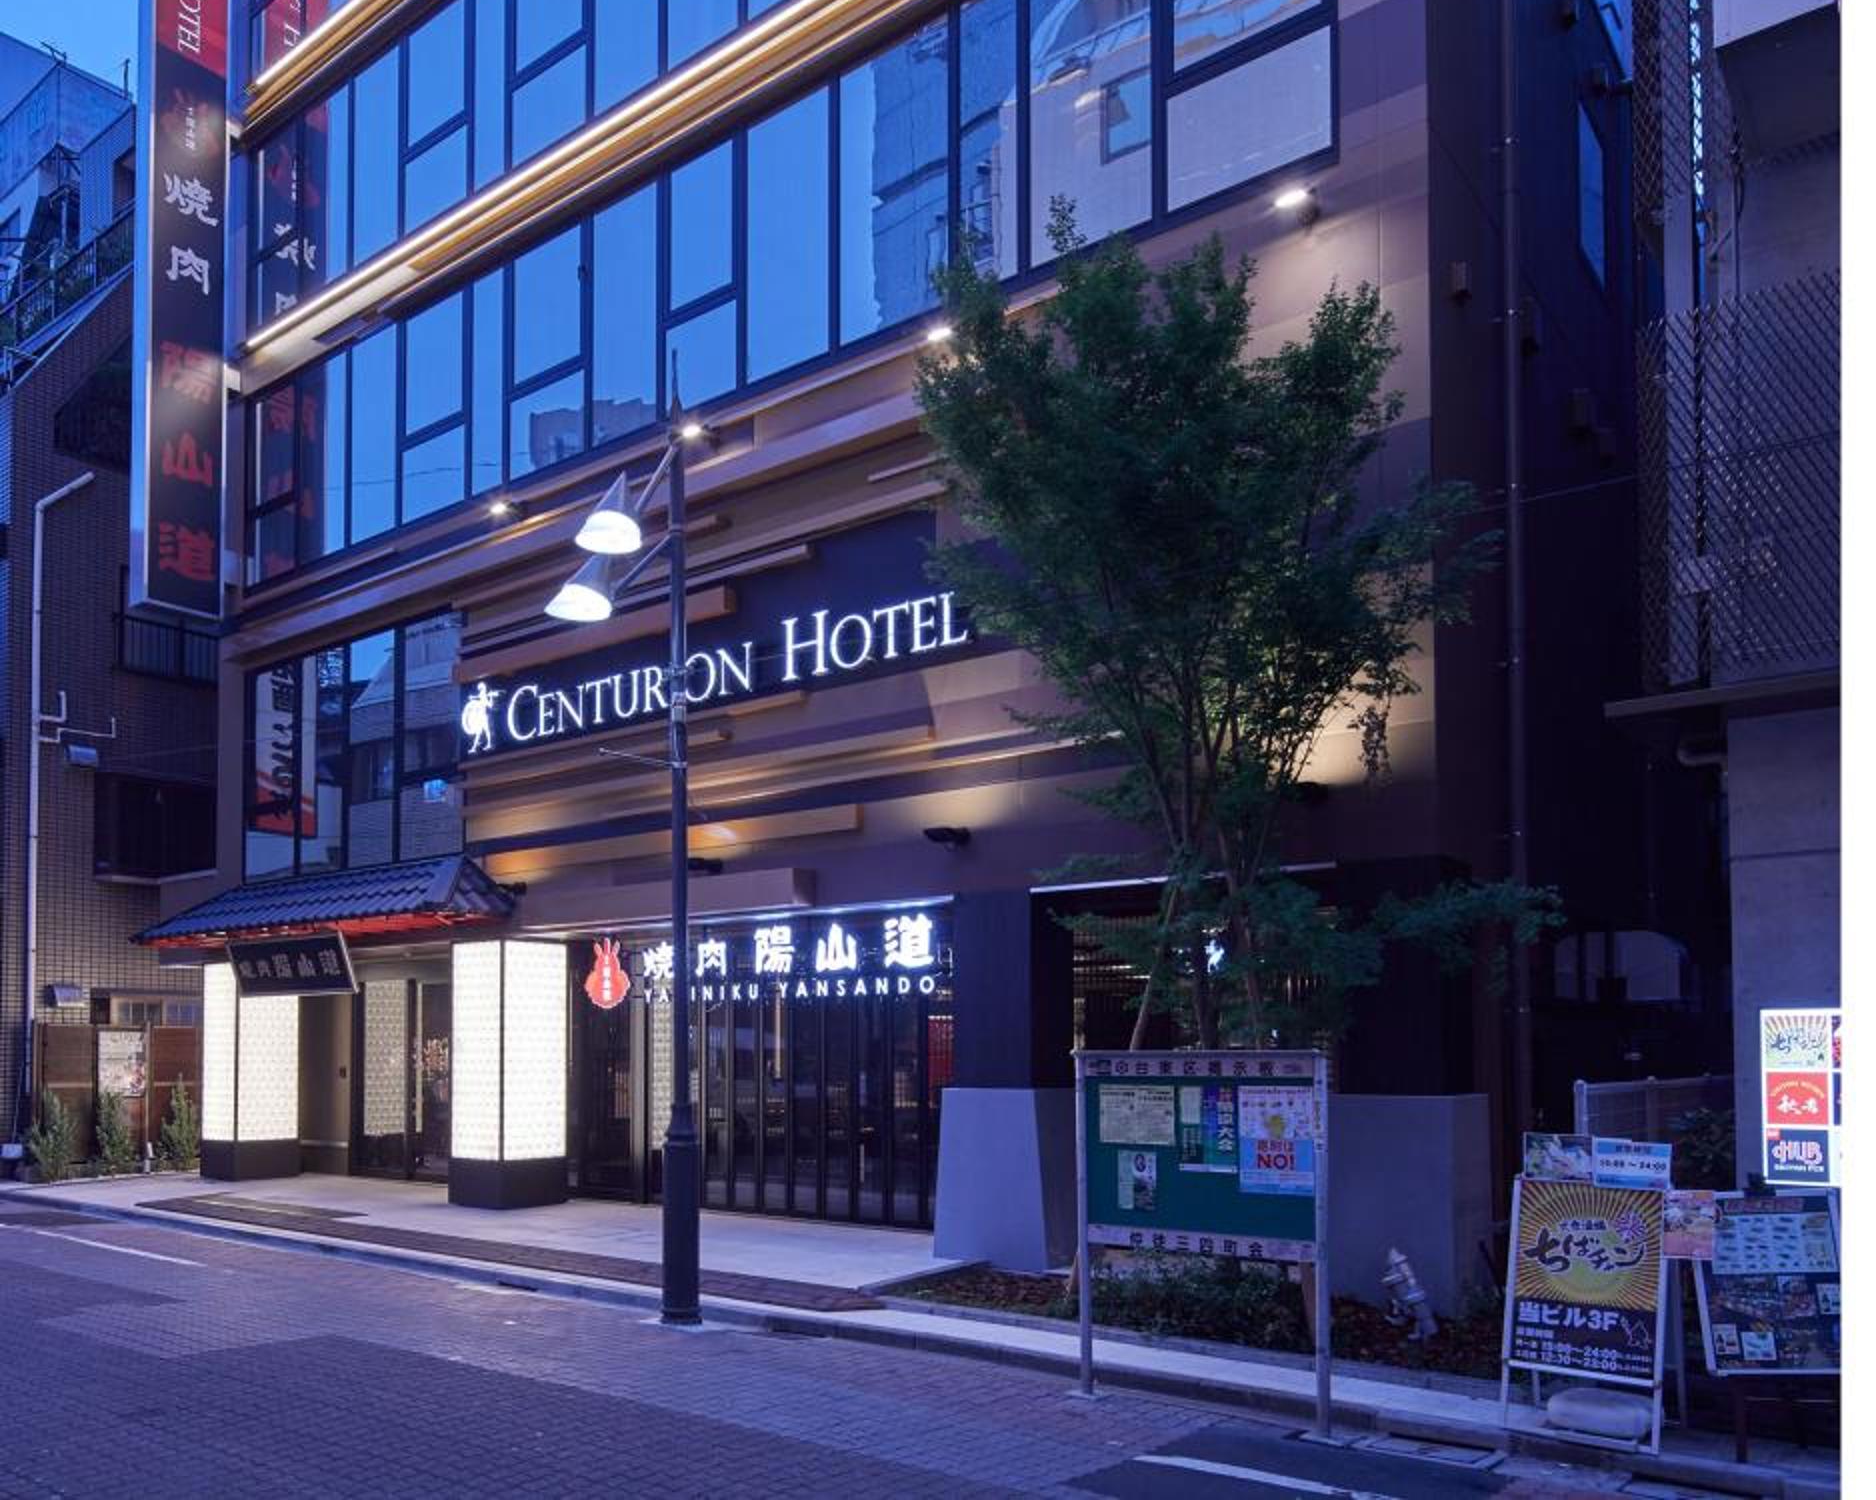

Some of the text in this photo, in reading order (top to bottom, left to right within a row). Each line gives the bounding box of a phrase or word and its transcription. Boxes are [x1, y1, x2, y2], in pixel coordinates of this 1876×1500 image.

[164, 173, 218, 295] 焼肉
[508, 591, 968, 741] CENTURON HOTEL
[644, 976, 935, 1004] YAINIKU YANSANDO
[1257, 1154, 1295, 1171] NO!
[1518, 1301, 1619, 1330] 当ビル3F
